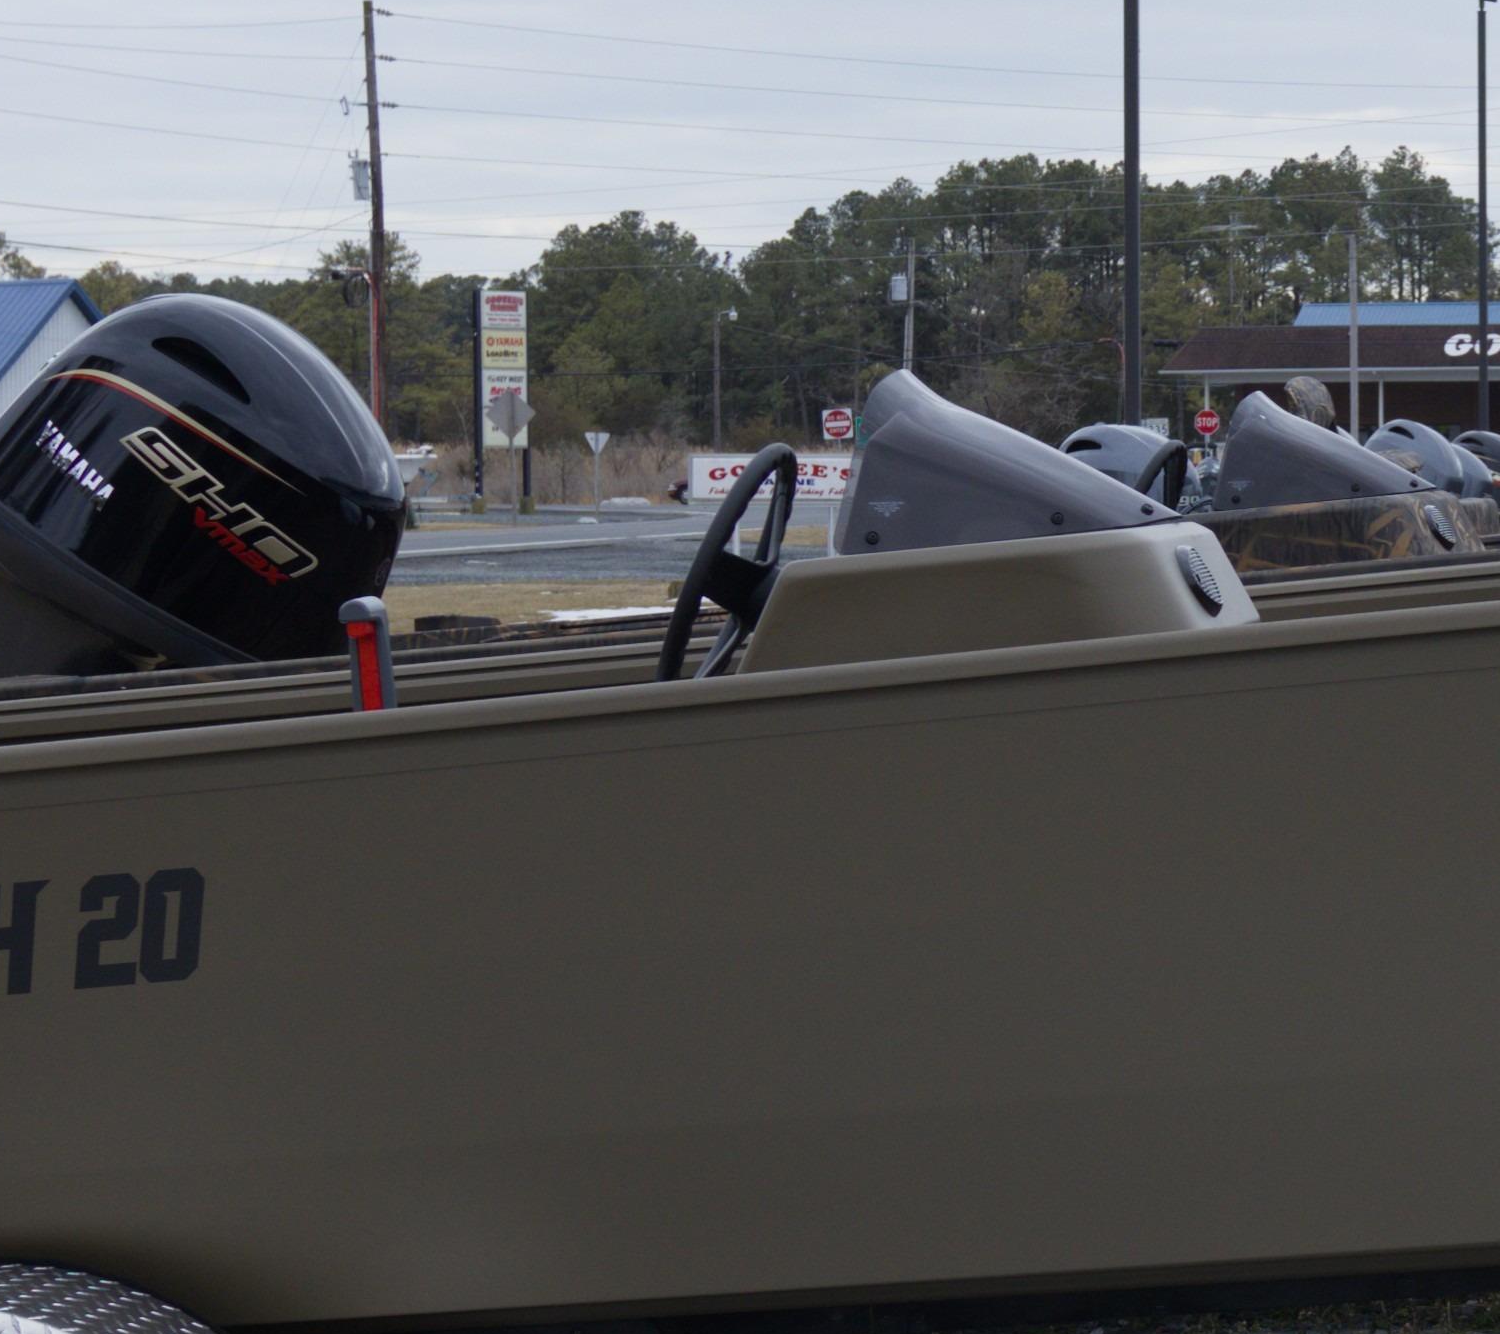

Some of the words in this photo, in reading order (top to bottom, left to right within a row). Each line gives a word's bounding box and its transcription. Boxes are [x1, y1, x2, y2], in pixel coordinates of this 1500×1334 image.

[36, 420, 114, 510] YAMAHA
[1196, 418, 1219, 427] STOP
[119, 427, 318, 578] SHO
[708, 463, 853, 481] GOEE'S
[74, 867, 205, 990] 20
